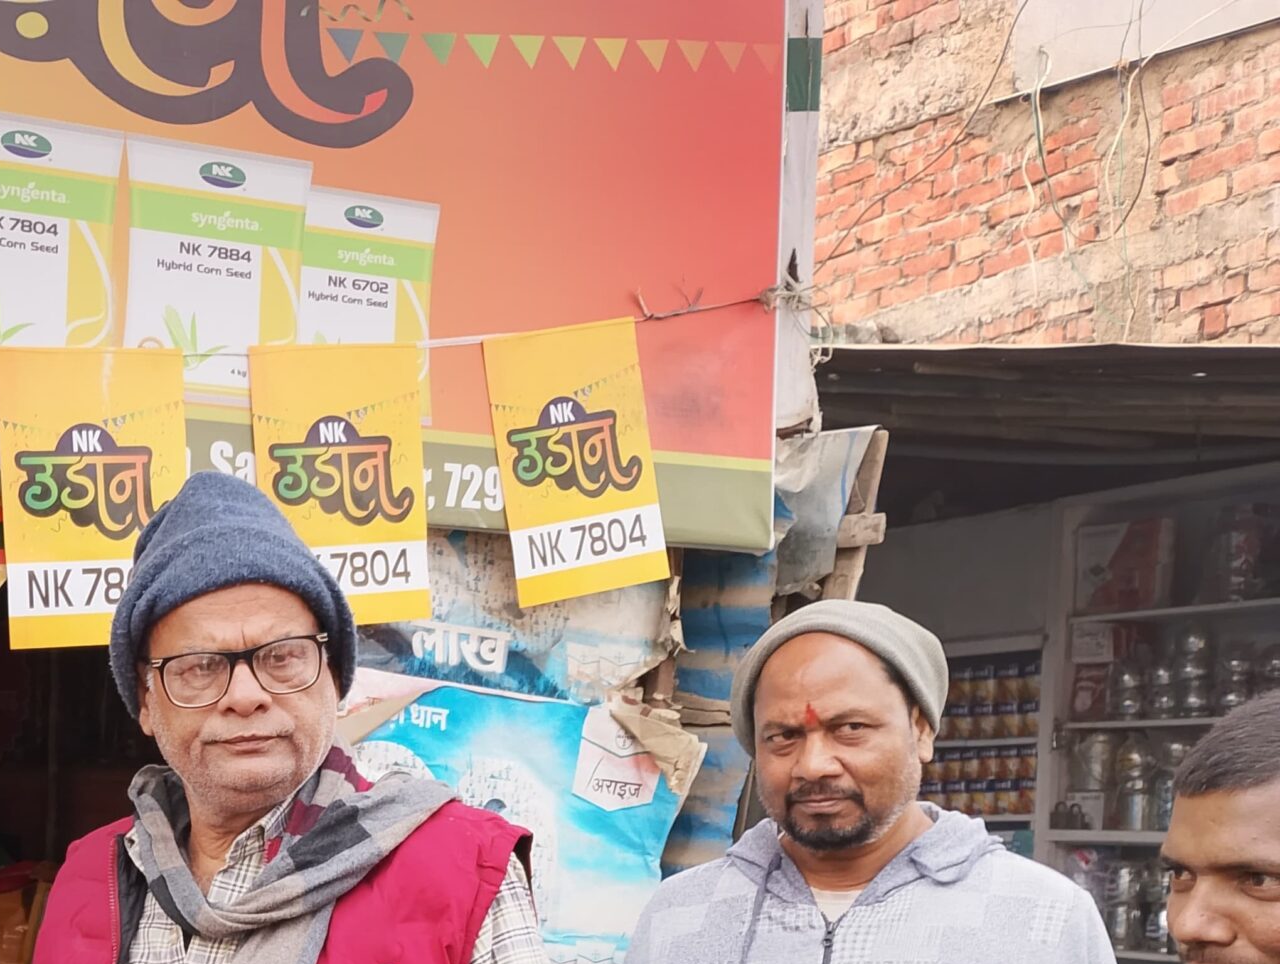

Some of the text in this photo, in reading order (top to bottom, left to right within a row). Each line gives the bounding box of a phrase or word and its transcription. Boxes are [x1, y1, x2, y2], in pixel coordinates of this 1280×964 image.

[15, 133, 38, 147] NK
[212, 164, 233, 178] NK
[191, 210, 260, 231] syngenta
[354, 207, 372, 219] NK
[9, 218, 58, 236] 7804
[0, 237, 26, 249] Corn
[31, 242, 58, 254] Seed
[179, 242, 251, 263] NK 7884
[338, 248, 394, 266] syngenta
[157, 259, 251, 279] Hybrid Corn Seed
[328, 275, 388, 294] NK 6702
[308, 291, 388, 308] Hybrid Corn Seed
[549, 401, 575, 425] NK
[72, 430, 102, 453] NK
[320, 421, 347, 443] NK
[210, 441, 256, 486] Sa
[528, 513, 647, 569] NK 7804
[329, 548, 411, 588] 7804
[28, 566, 132, 609] NK 78
[411, 620, 511, 674] लाख
